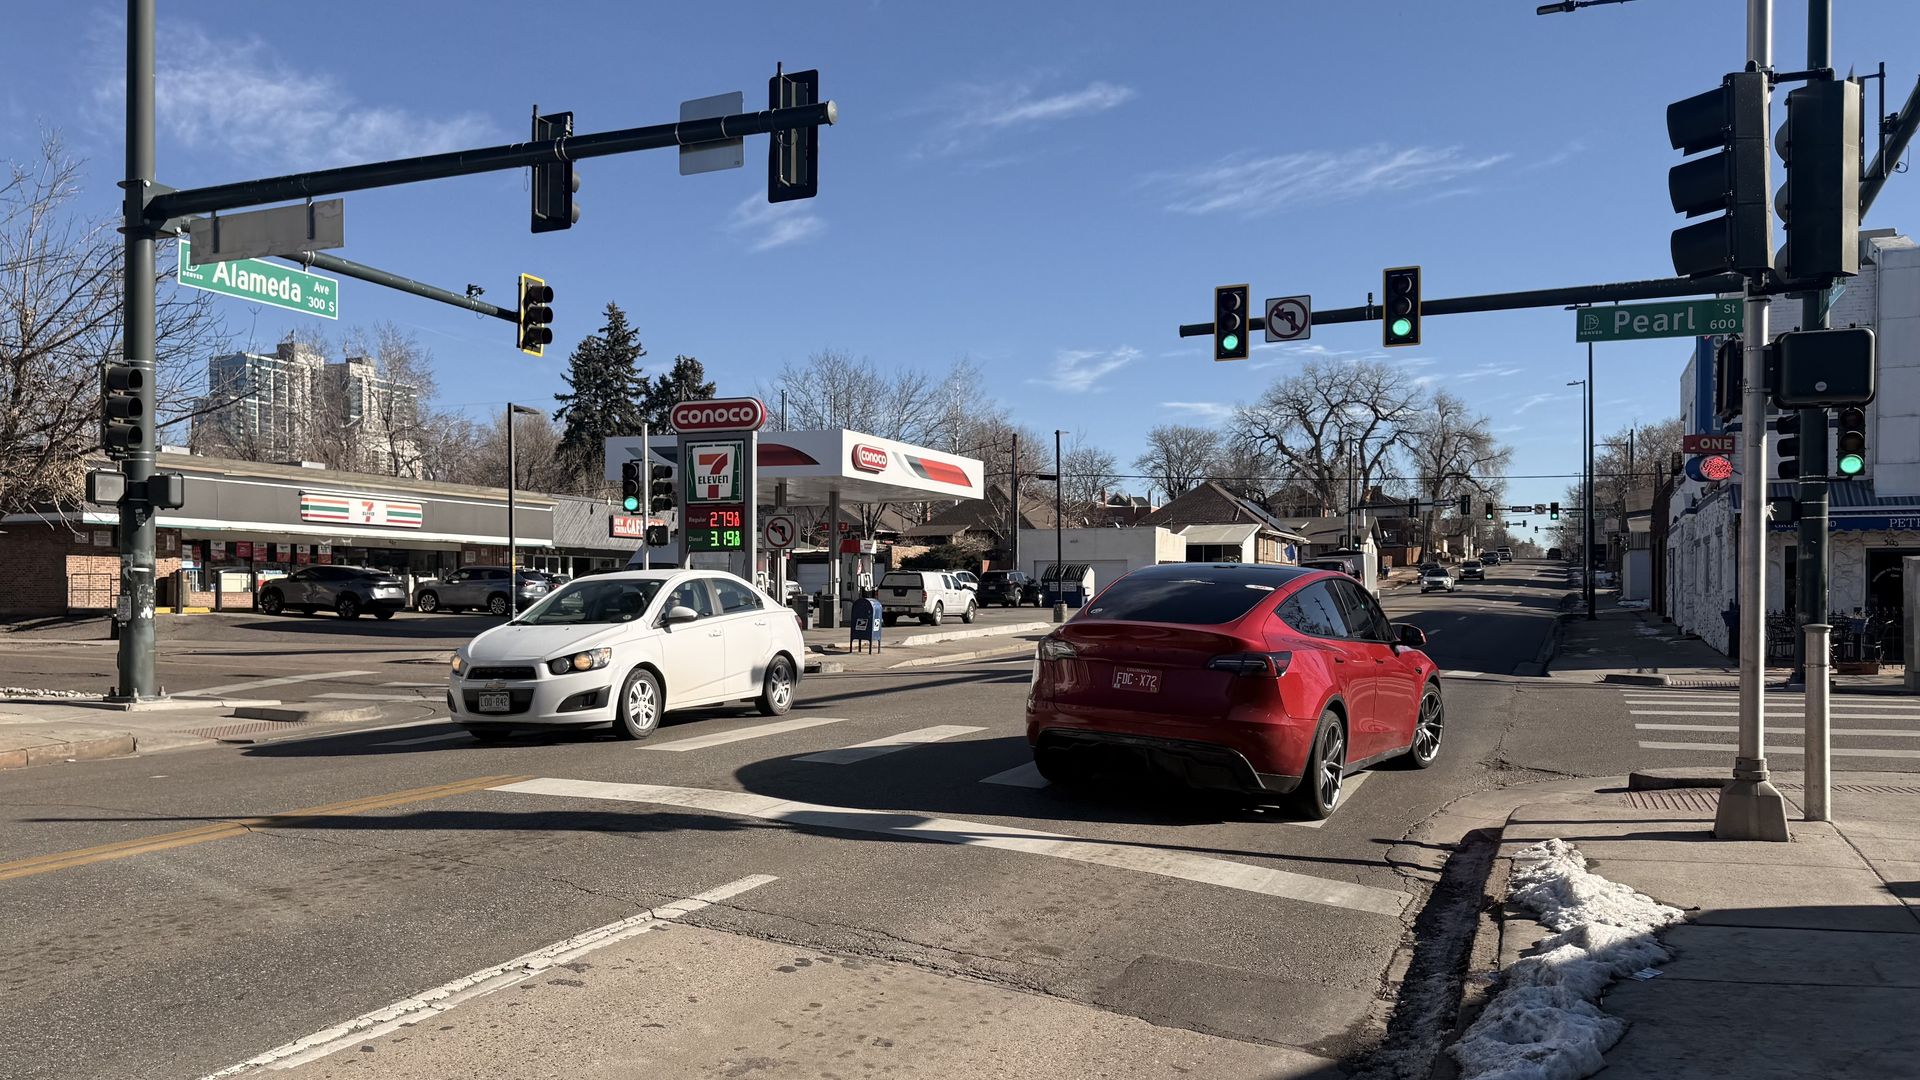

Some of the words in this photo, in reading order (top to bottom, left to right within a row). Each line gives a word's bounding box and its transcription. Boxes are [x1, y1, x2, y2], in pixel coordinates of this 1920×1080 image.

[212, 262, 302, 303] Alameda
[314, 282, 330, 295] Ave
[308, 298, 326, 311] 300
[328, 301, 335, 312] S
[1723, 304, 1736, 314] St
[1614, 306, 1696, 334] Pearl
[1710, 319, 1736, 330] 600
[1700, 438, 1733, 450] ONE
